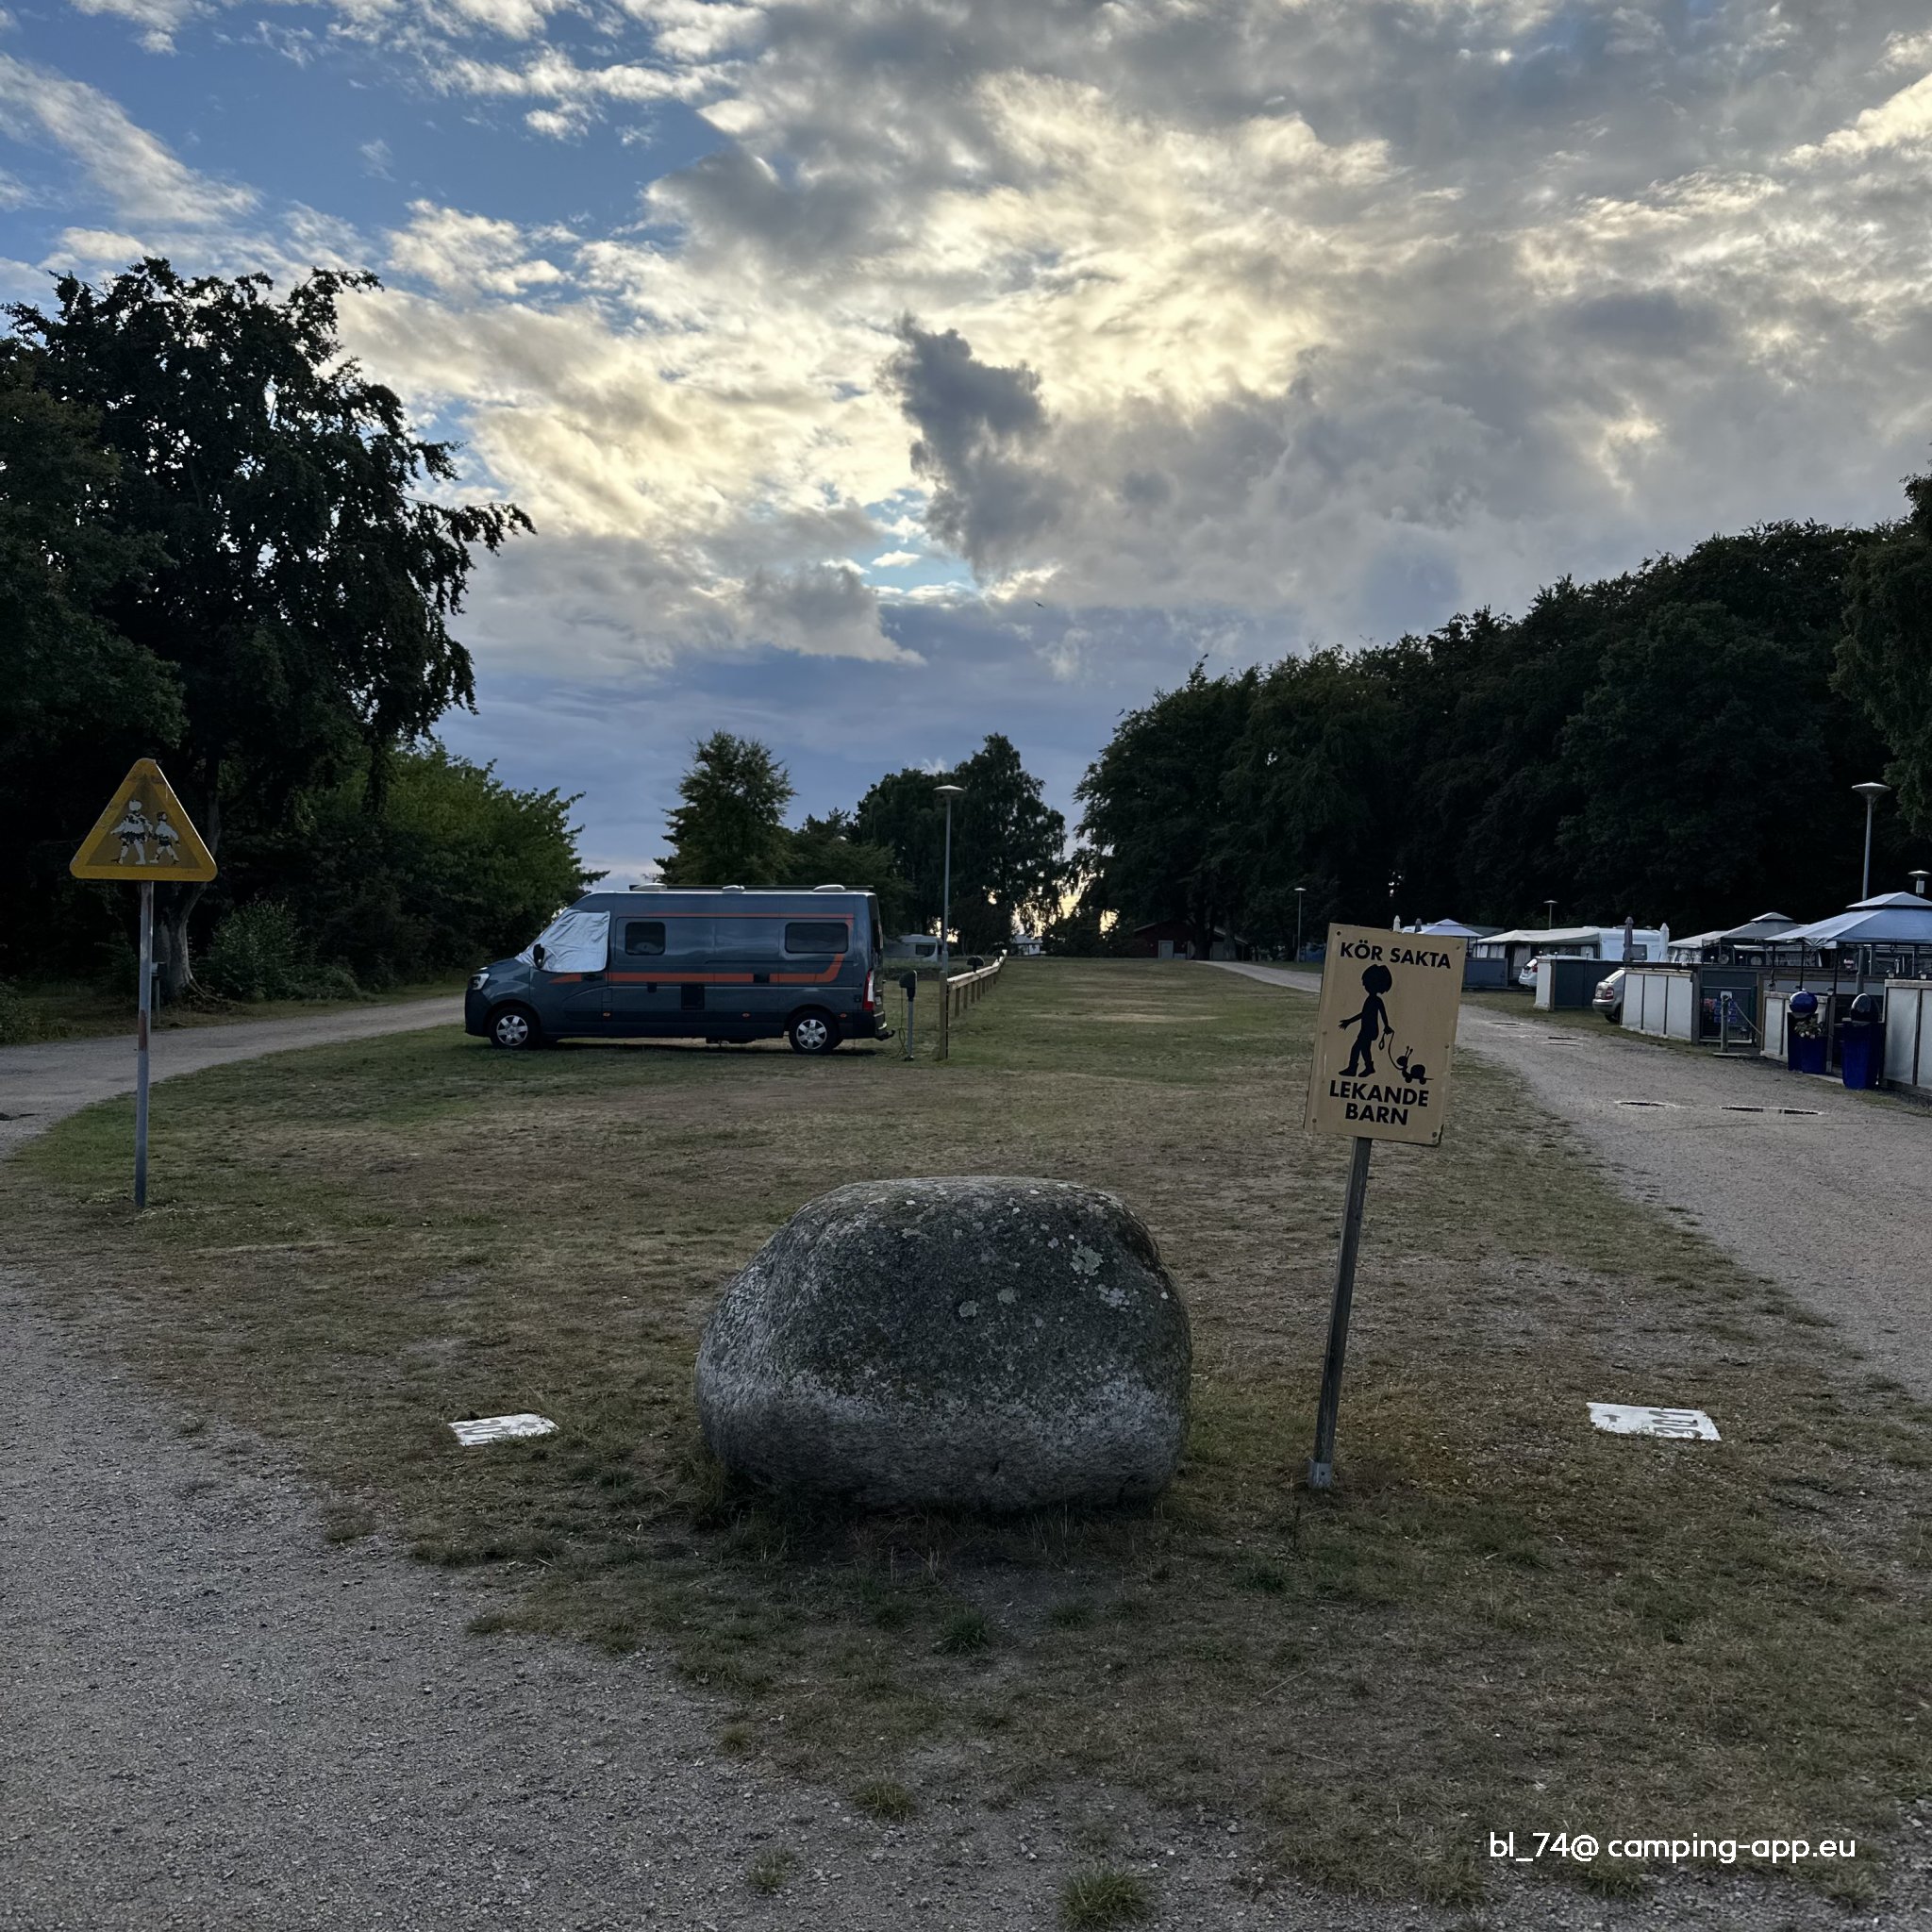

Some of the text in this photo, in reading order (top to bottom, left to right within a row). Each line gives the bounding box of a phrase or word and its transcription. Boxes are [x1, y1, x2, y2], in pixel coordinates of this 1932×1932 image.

[1340, 939, 1451, 969] KÖR SAKTA
[1329, 1079, 1429, 1108] LEKANDE
[1344, 1102, 1408, 1126] BARN
